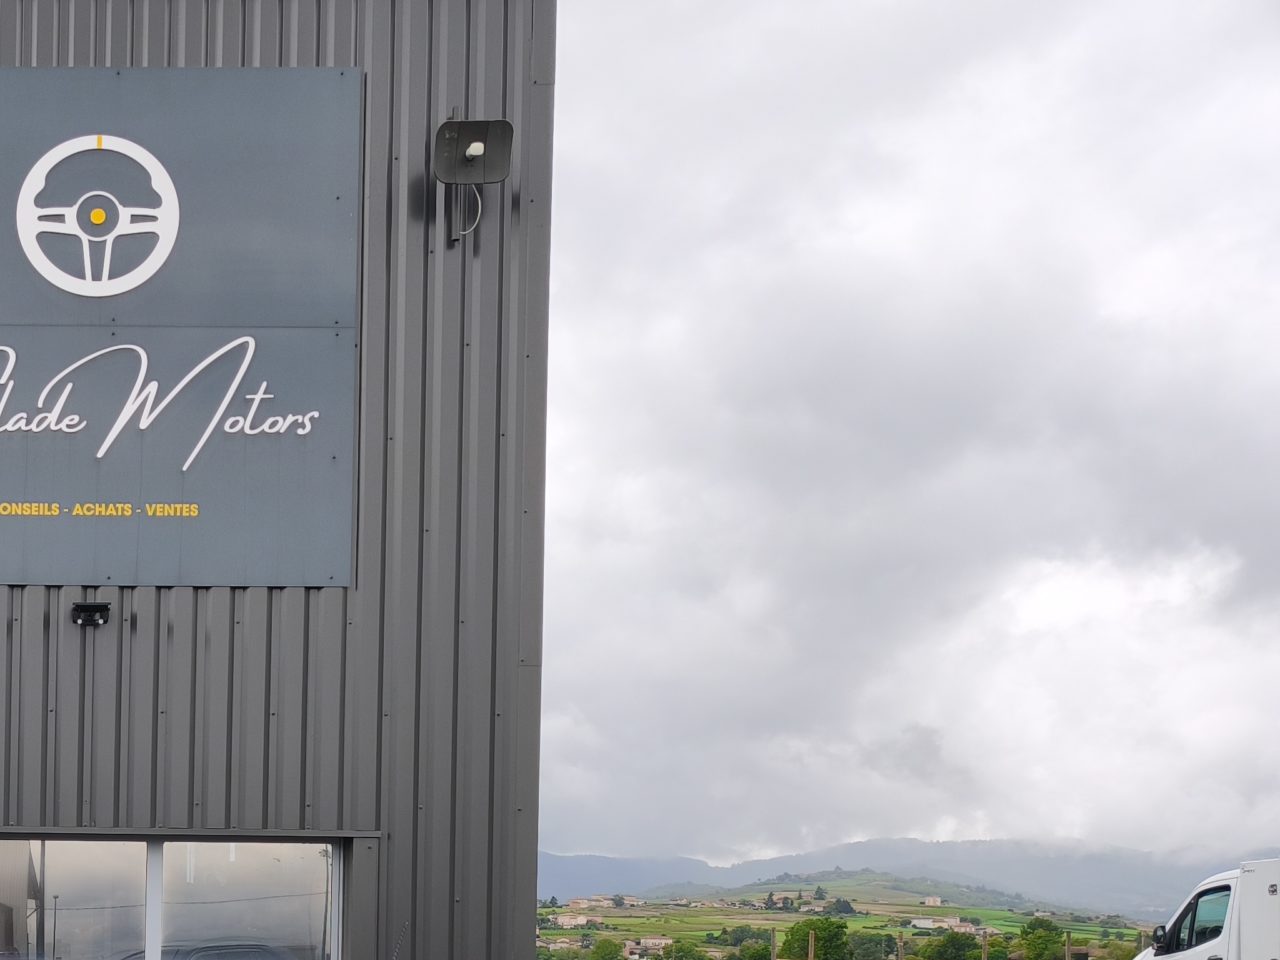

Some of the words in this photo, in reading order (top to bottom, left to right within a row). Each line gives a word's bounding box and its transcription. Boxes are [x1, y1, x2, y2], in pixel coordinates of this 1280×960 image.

[36, 336, 320, 472] Motors
[72, 503, 133, 517] ACHATS
[145, 503, 200, 518] VENTES
